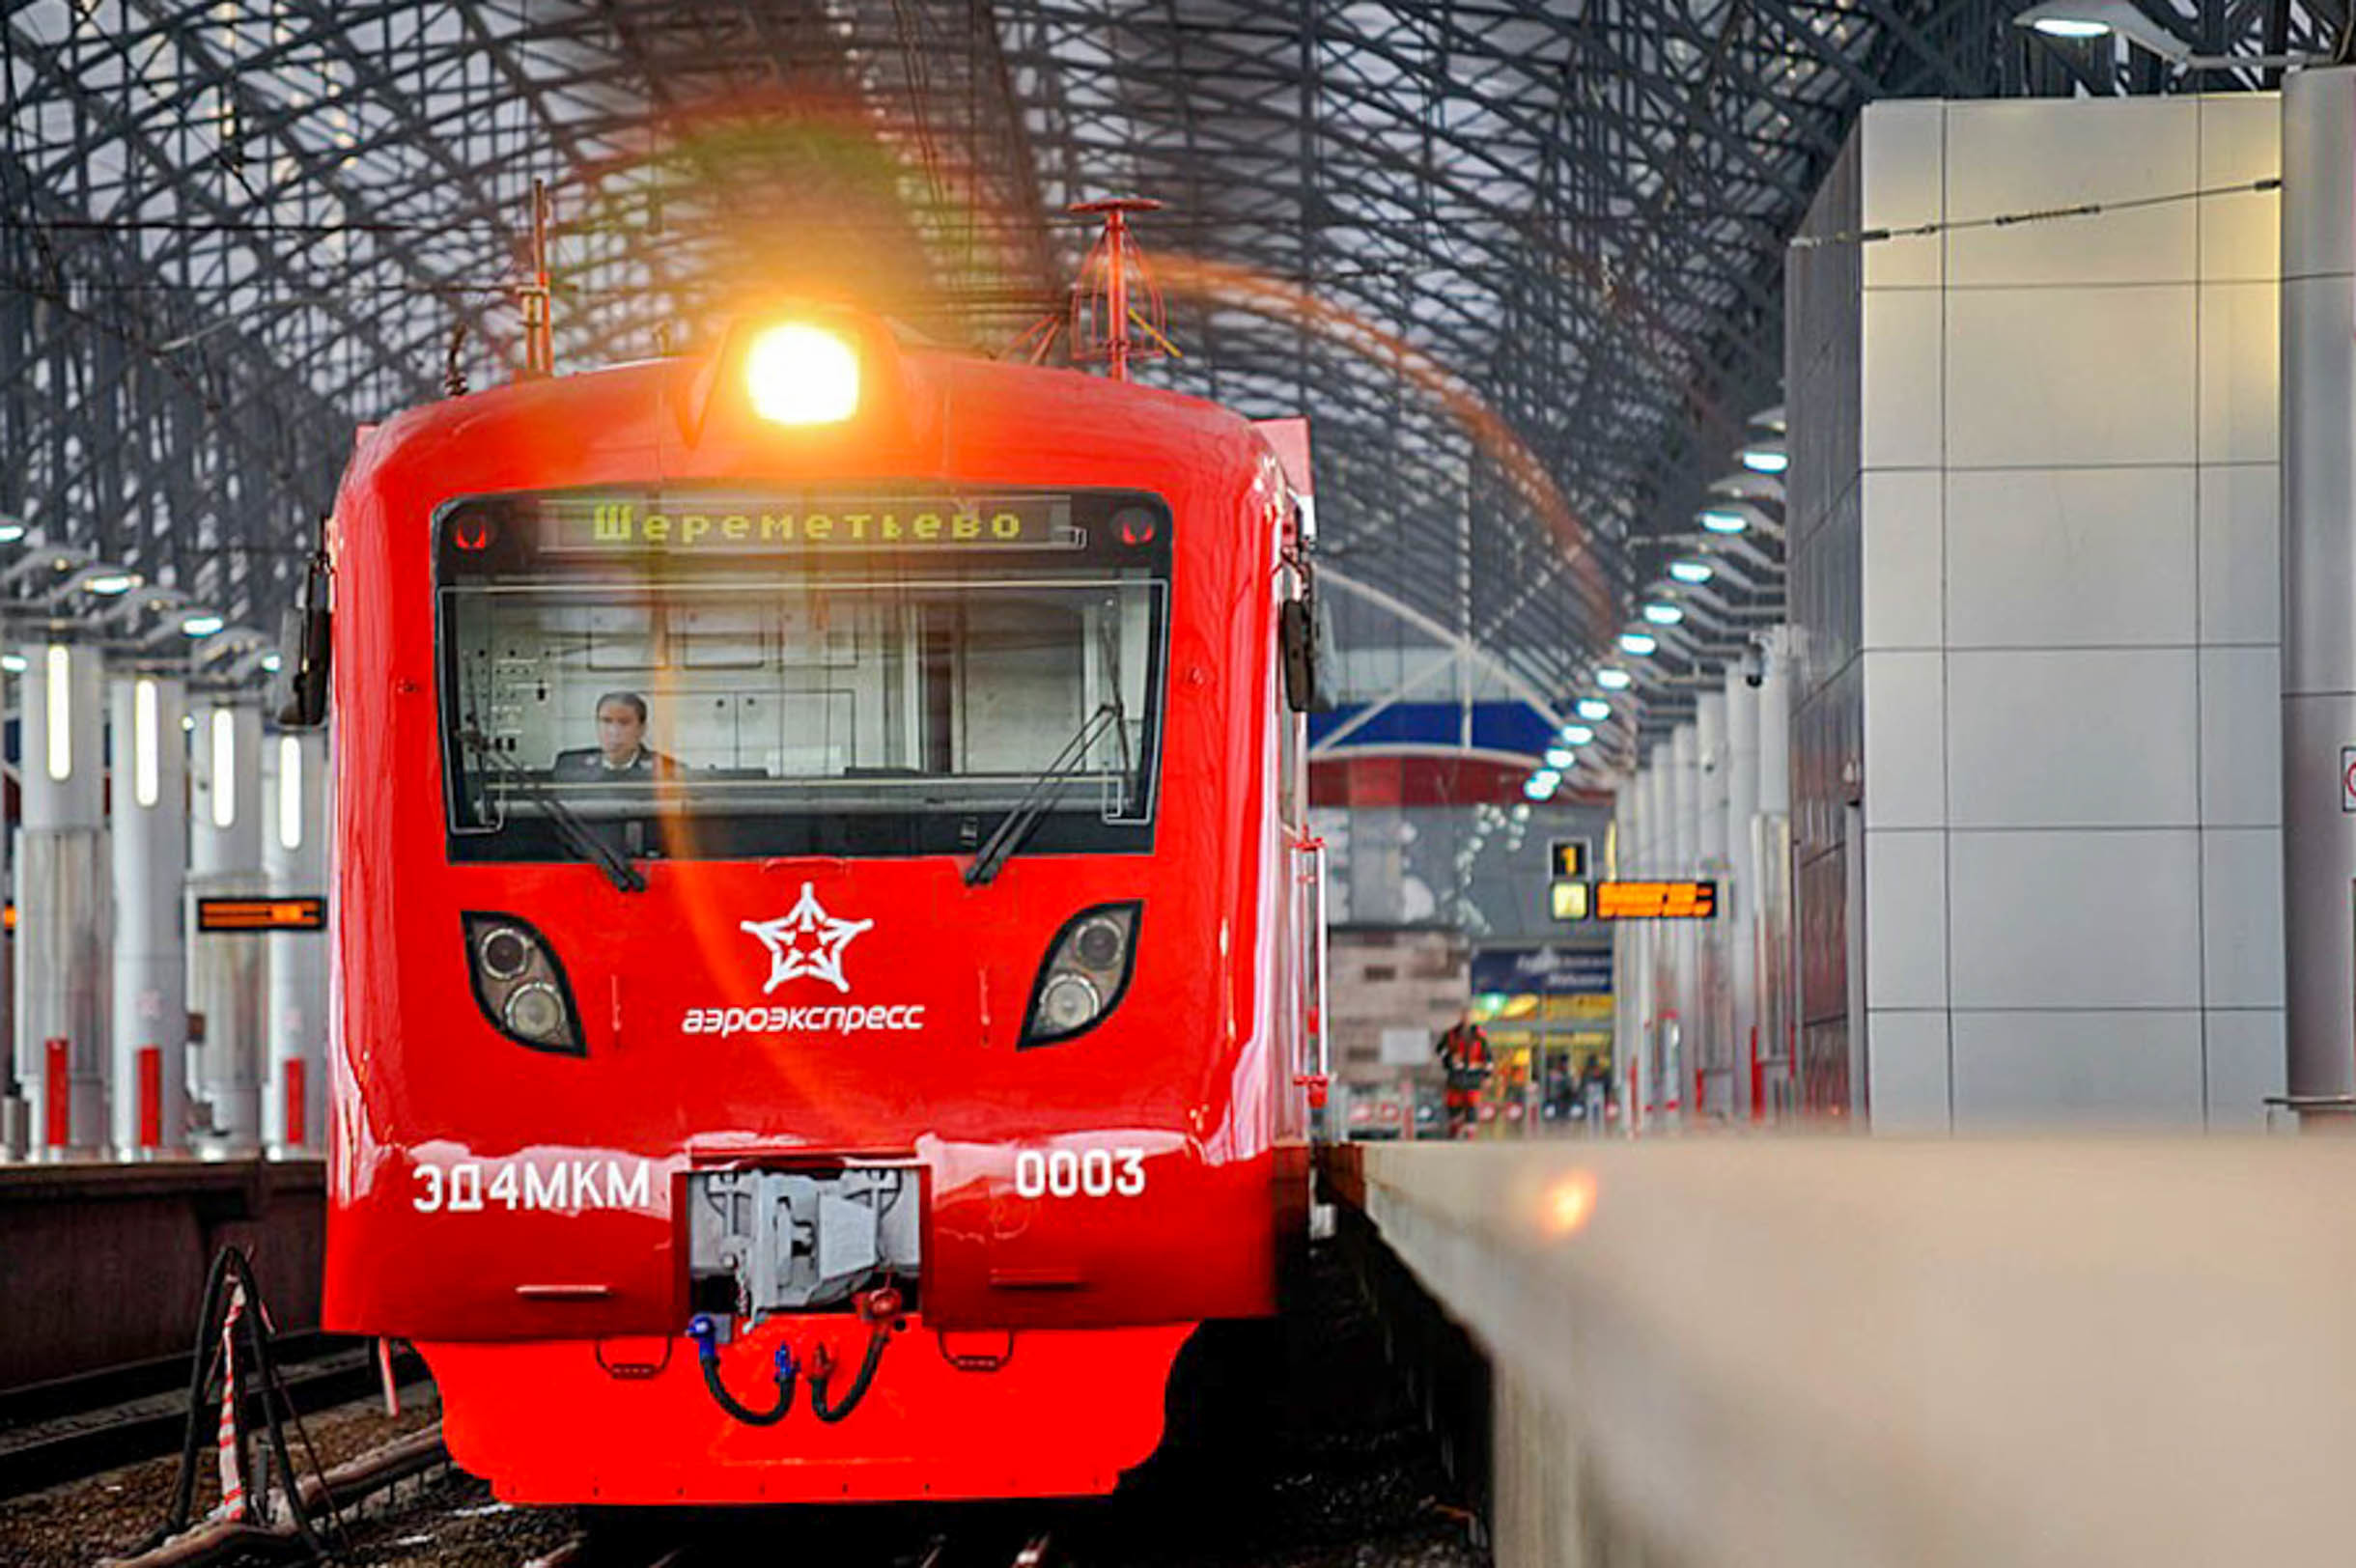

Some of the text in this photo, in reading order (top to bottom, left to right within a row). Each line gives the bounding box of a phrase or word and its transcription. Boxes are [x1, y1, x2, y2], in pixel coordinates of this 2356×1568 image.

[593, 505, 1021, 543] Шереметьево
[1561, 846, 1577, 875] 1
[681, 1005, 926, 1038] аэроэкспресс
[412, 1160, 650, 1212] ЭД4МКМ
[1016, 1148, 1146, 1197] 0003
